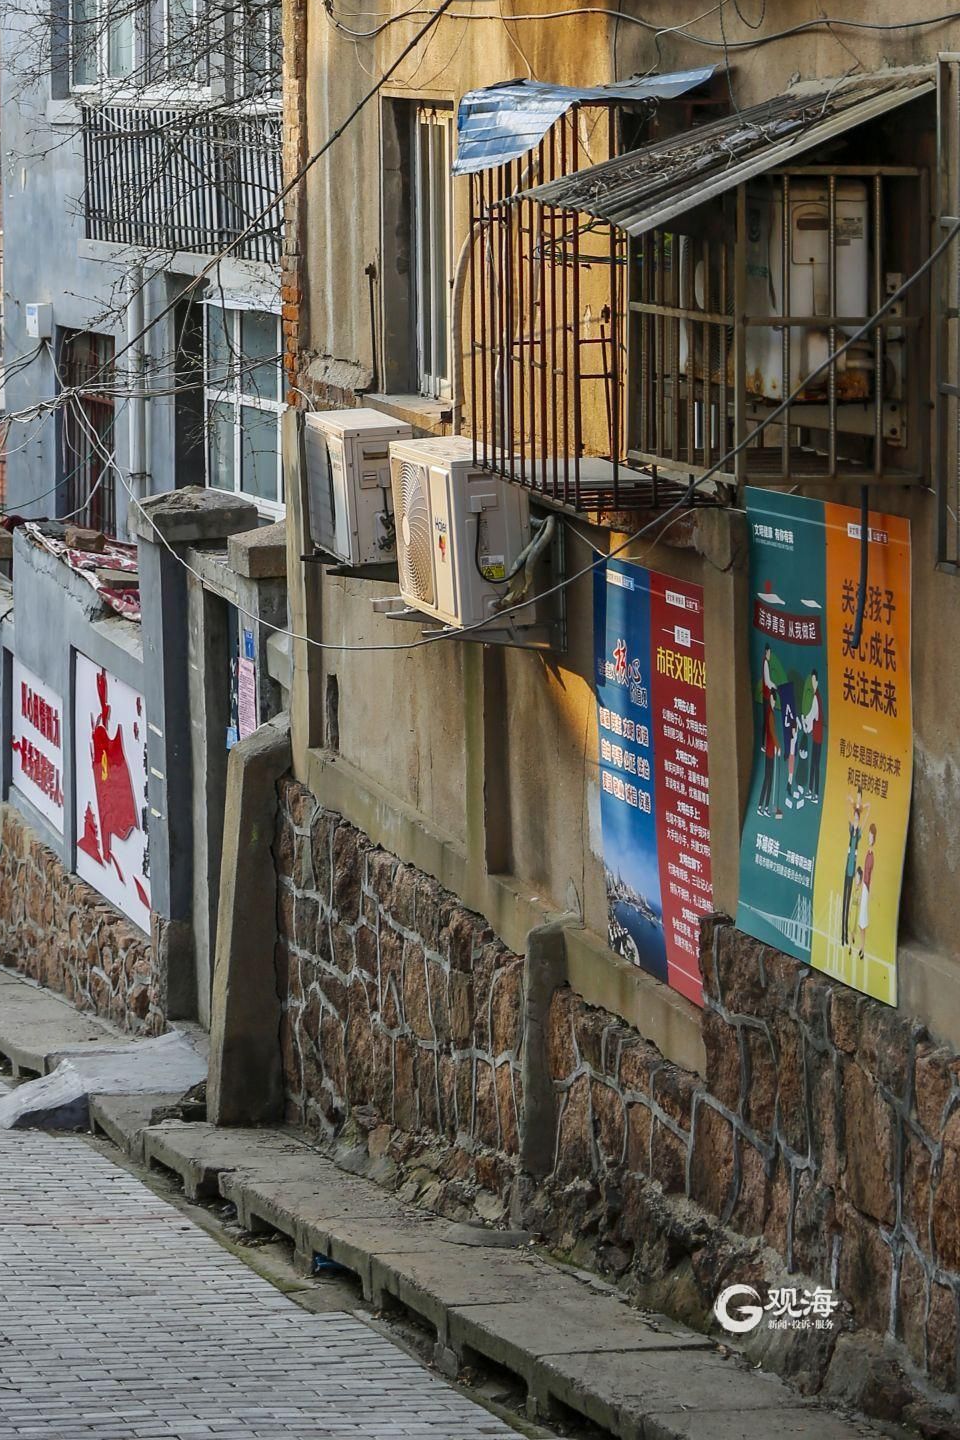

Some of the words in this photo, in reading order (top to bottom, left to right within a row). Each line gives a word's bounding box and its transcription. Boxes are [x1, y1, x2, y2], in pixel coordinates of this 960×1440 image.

[842, 578, 896, 626] 关孩子
[759, 606, 785, 636] 洁净青岛
[788, 619, 817, 641] 从我做起
[843, 667, 897, 718] 关注未来
[840, 738, 902, 777] 青少年是国家的未来
[848, 766, 889, 800] 和民族的希望
